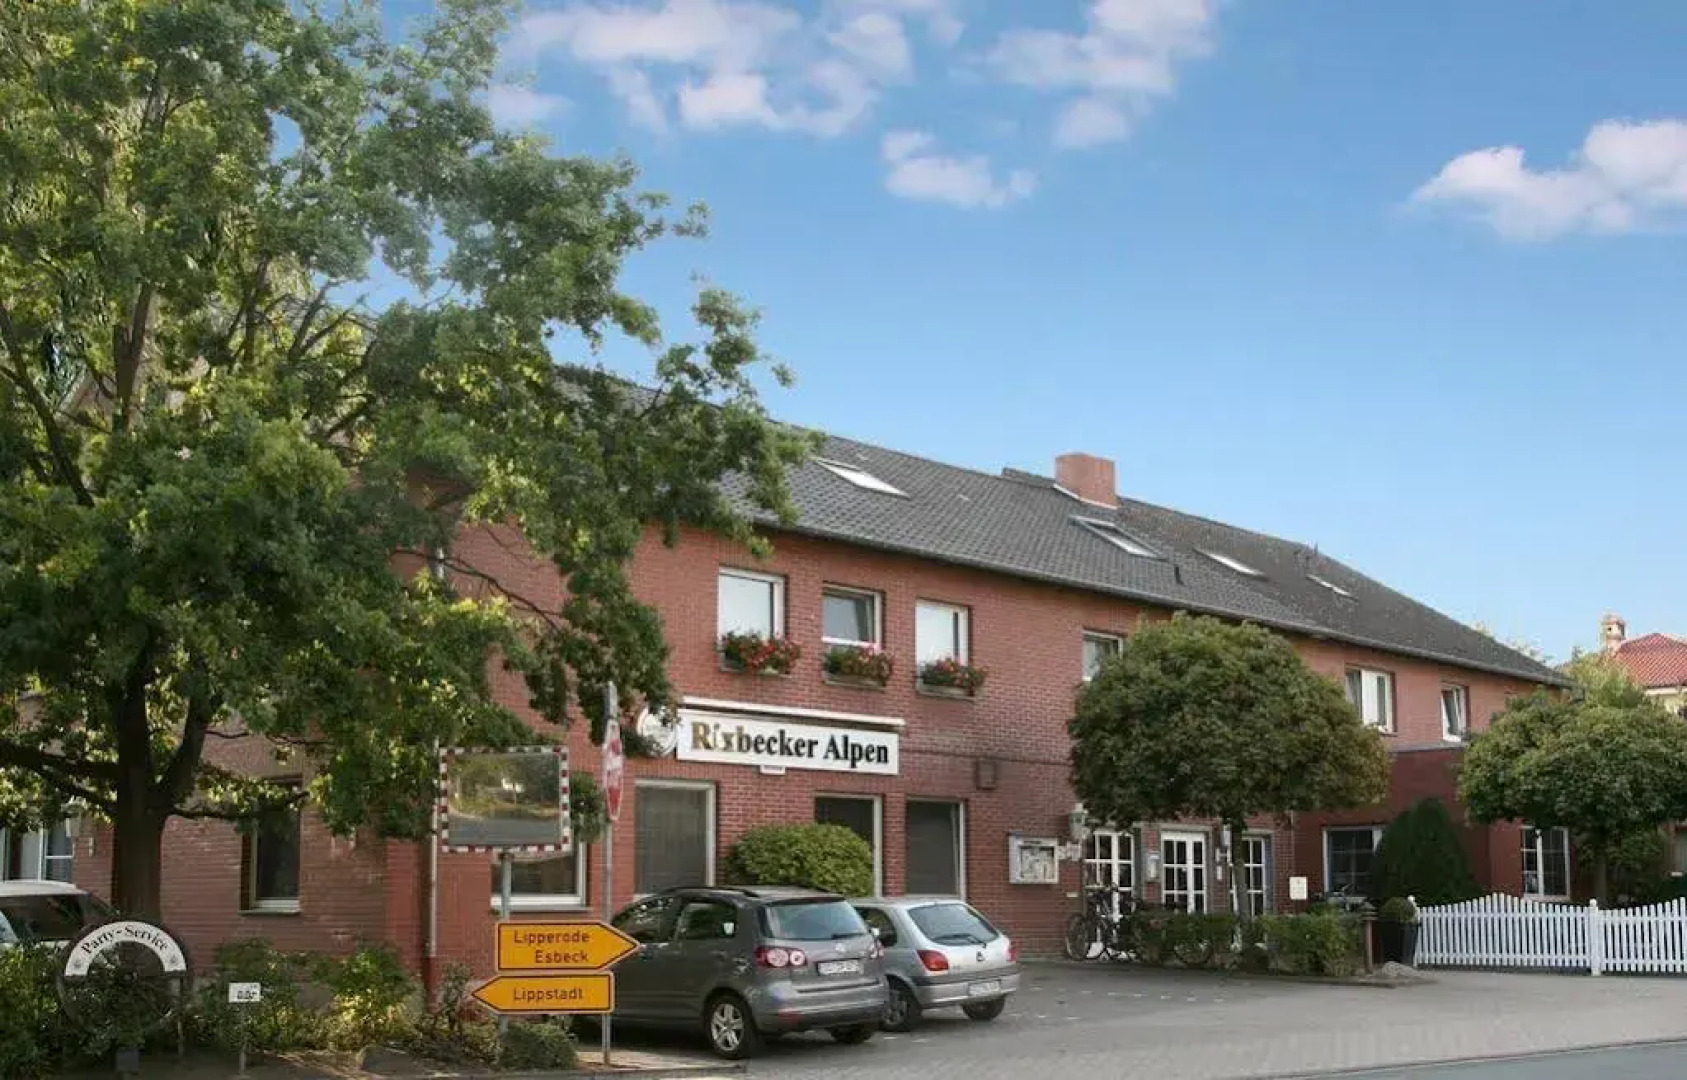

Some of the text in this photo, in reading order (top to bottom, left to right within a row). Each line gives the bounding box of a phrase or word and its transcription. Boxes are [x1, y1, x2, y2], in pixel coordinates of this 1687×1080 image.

[691, 721, 888, 768] Rixbecker Alpen
[513, 930, 590, 944] Lipperode
[535, 949, 589, 963] Esbeck
[513, 986, 583, 1001] Lippstadt
